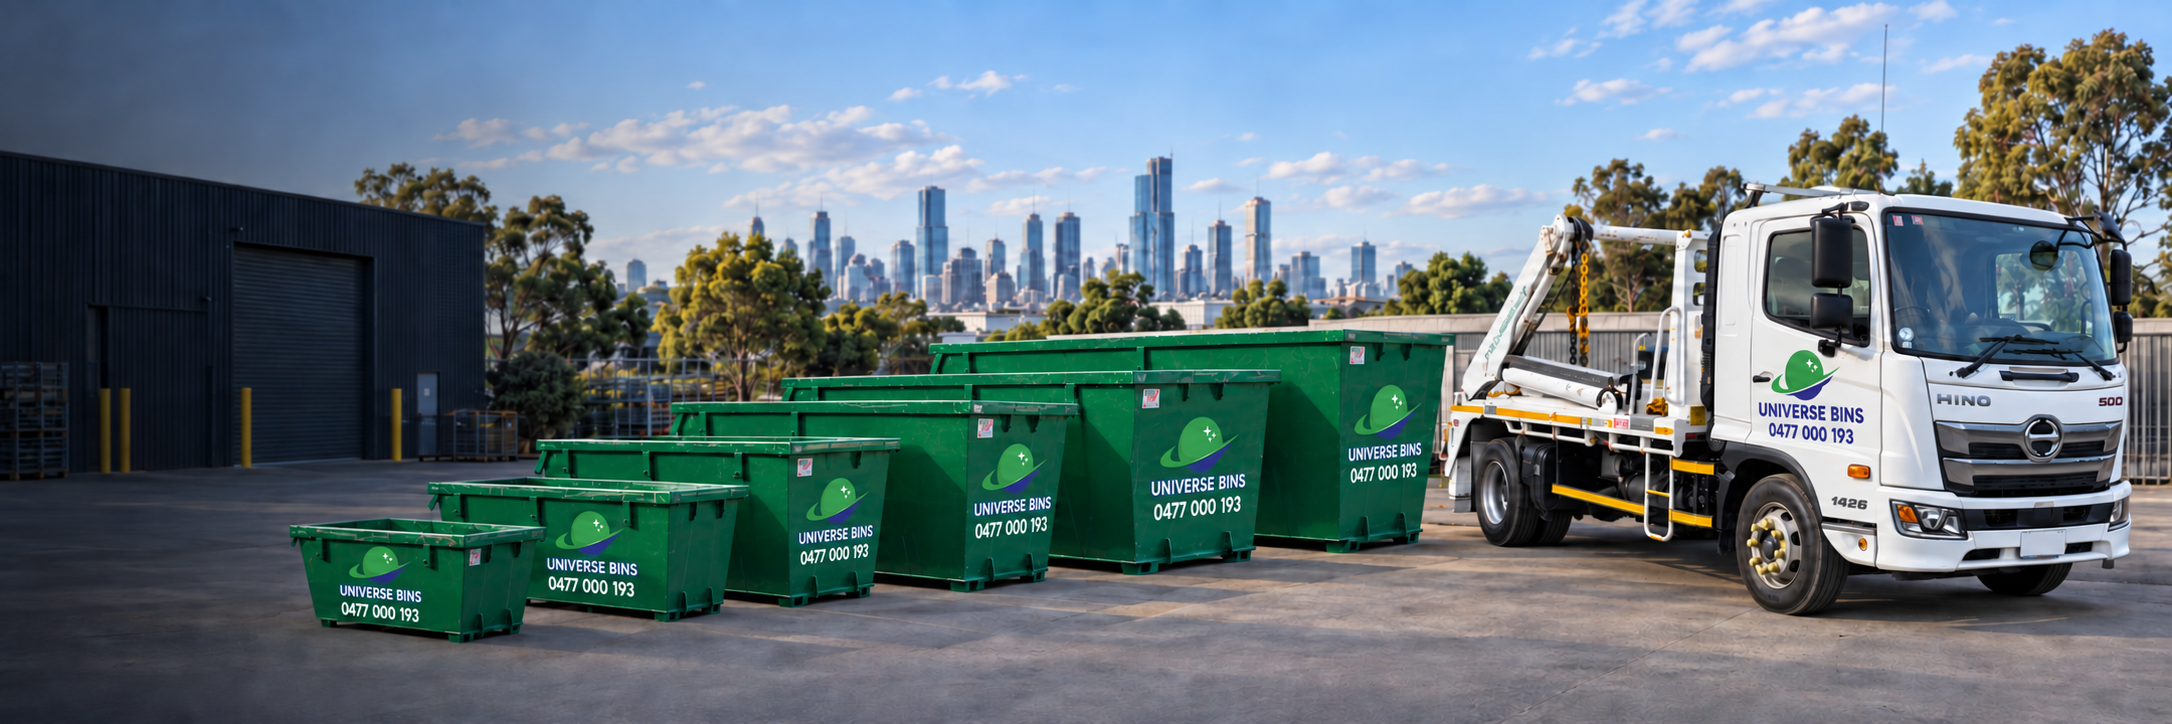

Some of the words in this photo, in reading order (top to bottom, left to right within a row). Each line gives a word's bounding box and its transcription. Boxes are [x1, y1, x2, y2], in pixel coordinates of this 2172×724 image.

[1936, 393, 1992, 407] HINO
[1758, 401, 1827, 422] UNIVERSE
[1830, 405, 1865, 424] BINS
[1768, 422, 1799, 440] 0477
[1801, 424, 1828, 443] 000
[1830, 427, 1854, 445] 193
[1348, 444, 1398, 462] UNIVERSE
[1399, 442, 1422, 457] BINS
[1350, 466, 1376, 484] 0477
[1377, 464, 1399, 481] 000
[1401, 462, 1417, 479] 193
[1151, 476, 1215, 497] UNIVERSE
[1218, 473, 1246, 490] BINS
[974, 498, 1027, 517] UNIVERSE
[1028, 496, 1052, 511] BINS
[1153, 500, 1187, 521] 0477
[1190, 498, 1217, 517] 000
[1220, 495, 1241, 514] 193
[1831, 495, 1868, 511] 1426
[798, 527, 849, 545] UNIVERSE
[851, 524, 874, 539] BINS
[974, 520, 1003, 540] 0477
[1005, 518, 1028, 536] 000
[1030, 515, 1049, 533] 193
[800, 548, 827, 566] 0477
[828, 545, 850, 562] 000
[852, 543, 869, 559] 193
[547, 557, 606, 574] UNIVERSE
[609, 561, 638, 577] BINS
[339, 584, 394, 601] UNIVERSE
[396, 589, 422, 603] BINS
[548, 575, 579, 592] 0477
[582, 578, 609, 595] 000
[612, 580, 635, 598] 193
[341, 601, 369, 618] 0477
[372, 604, 396, 620] 000
[399, 607, 420, 623] 193
